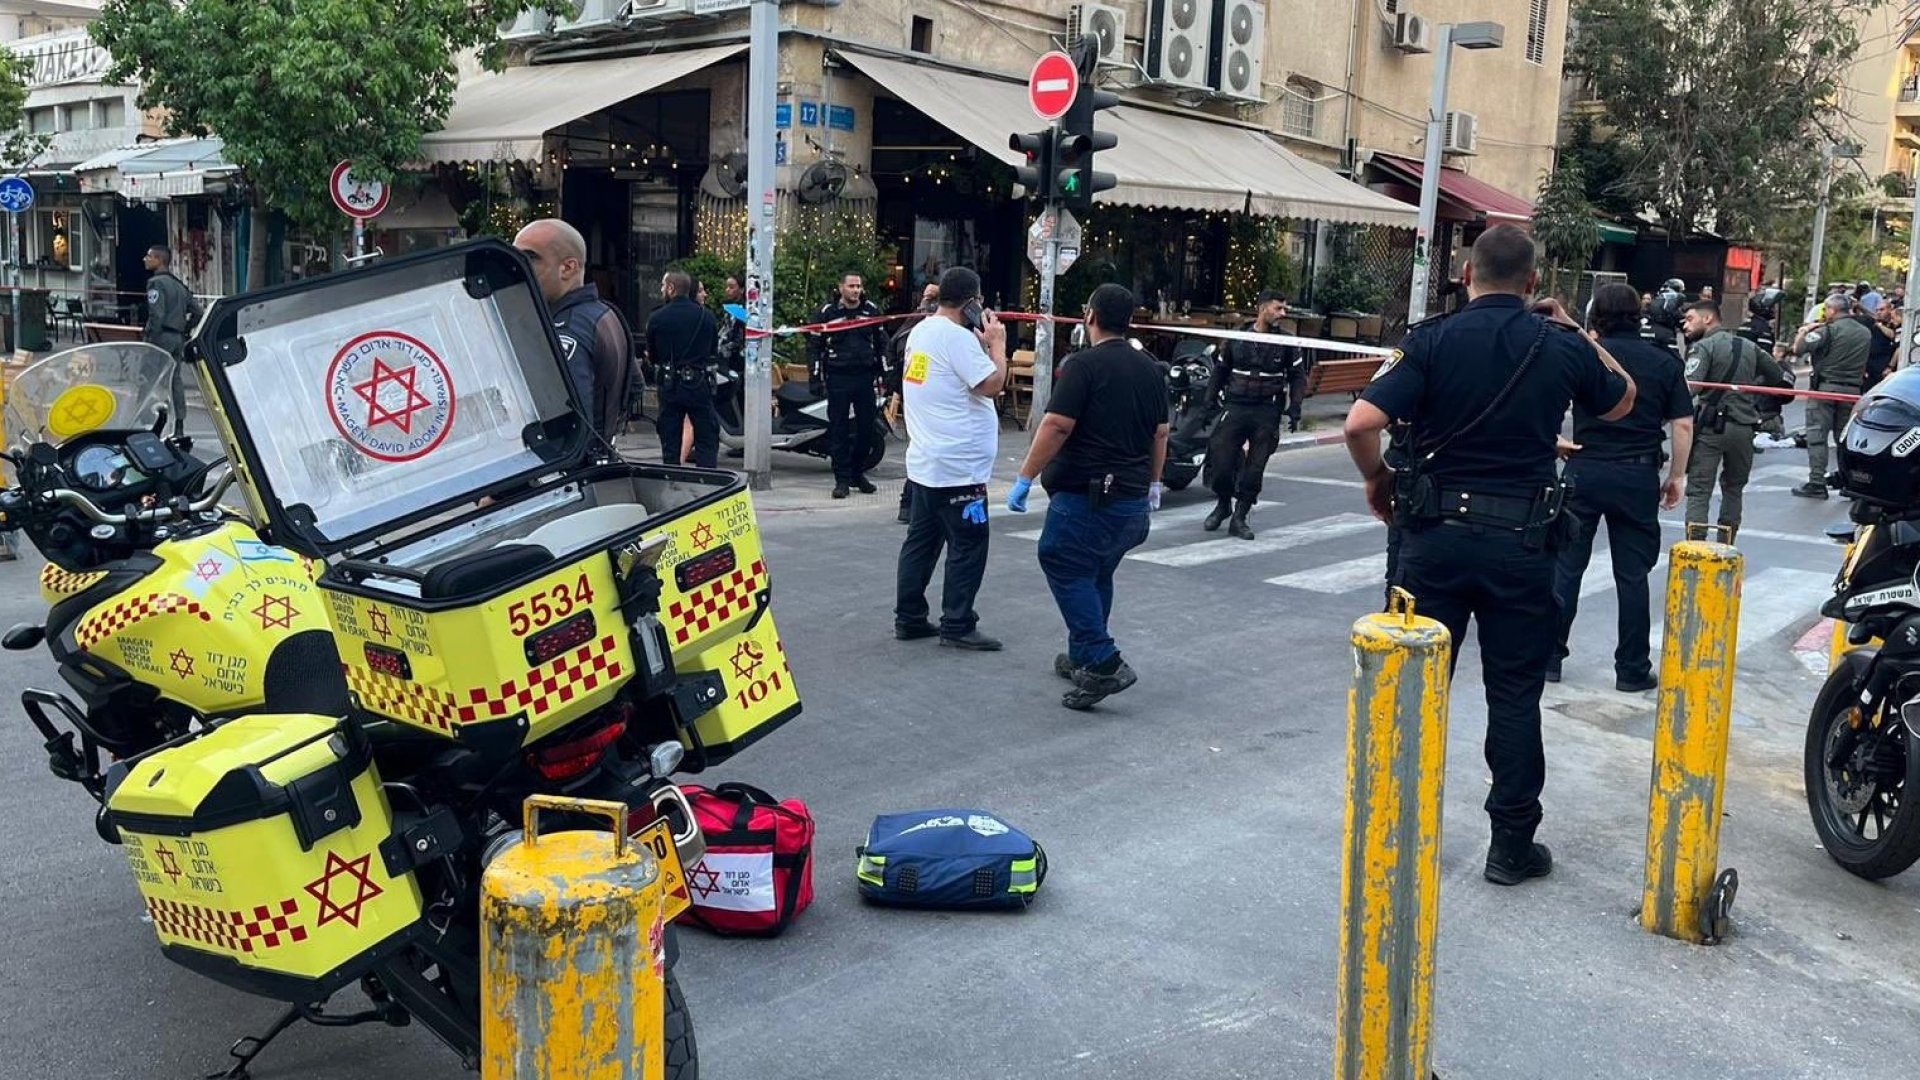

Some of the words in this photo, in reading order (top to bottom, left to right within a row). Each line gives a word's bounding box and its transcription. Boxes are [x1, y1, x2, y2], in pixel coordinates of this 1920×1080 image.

[802, 106, 816, 121] 17
[360, 340, 391, 355] אדום
[395, 340, 414, 354] דוד
[337, 401, 367, 443] MAGEN
[369, 438, 405, 453] DAVID
[409, 424, 439, 450] ADOM
[433, 371, 446, 411] ISRAEL
[245, 579, 261, 592] לך
[1880, 589, 1912, 600] משטרת
[508, 573, 594, 637] 5534
[206, 651, 223, 664] דוד
[227, 656, 247, 669] מגן
[216, 667, 246, 682] אדום
[202, 674, 244, 695] בישראל
[735, 671, 782, 710] 101
[725, 871, 736, 879] דוד
[738, 871, 750, 880] מגן
[731, 880, 750, 888] אדום
[721, 887, 750, 896] בישראל
